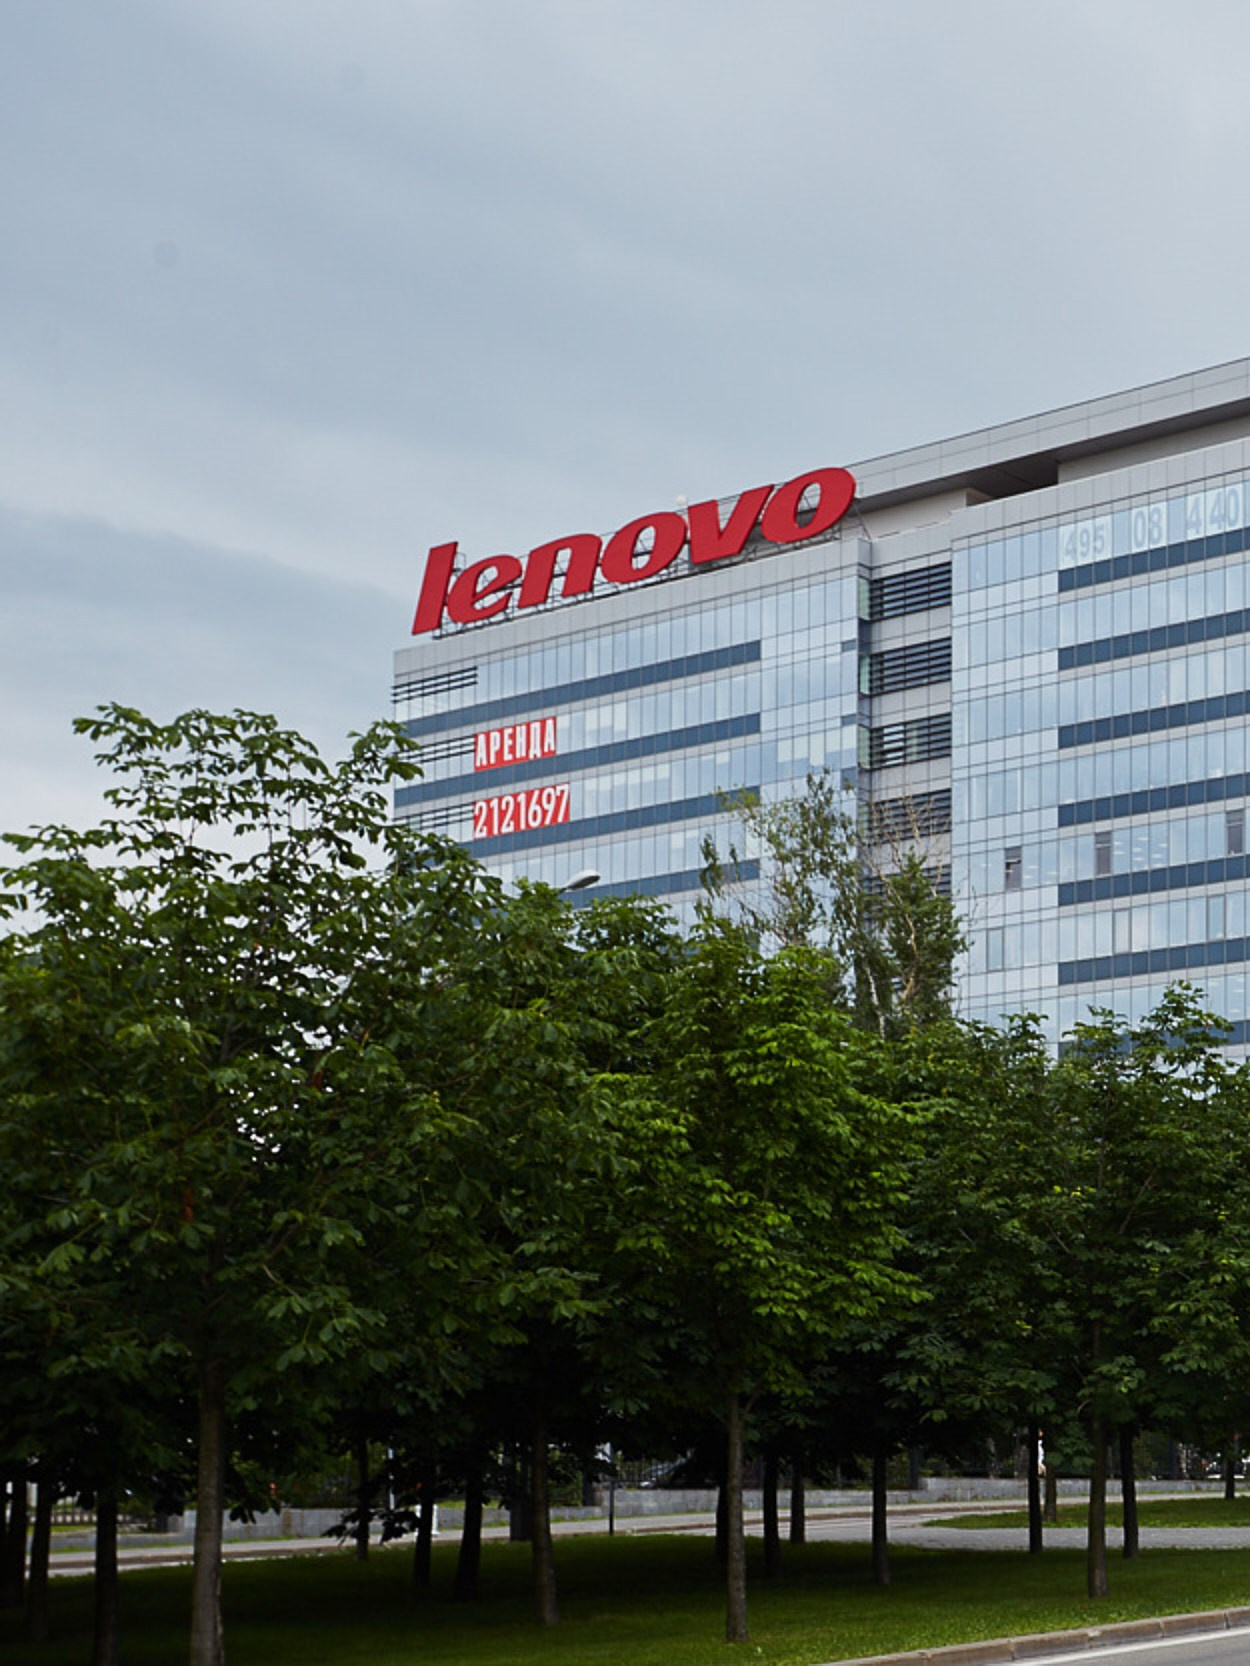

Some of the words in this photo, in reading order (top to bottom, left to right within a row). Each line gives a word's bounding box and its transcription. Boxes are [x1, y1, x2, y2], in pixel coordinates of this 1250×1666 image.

[412, 467, 856, 635] lenovo
[1065, 524, 1105, 560] 495
[1133, 508, 1162, 549] 08
[475, 718, 555, 767] АРЕНДА
[475, 783, 569, 838] 2121697
